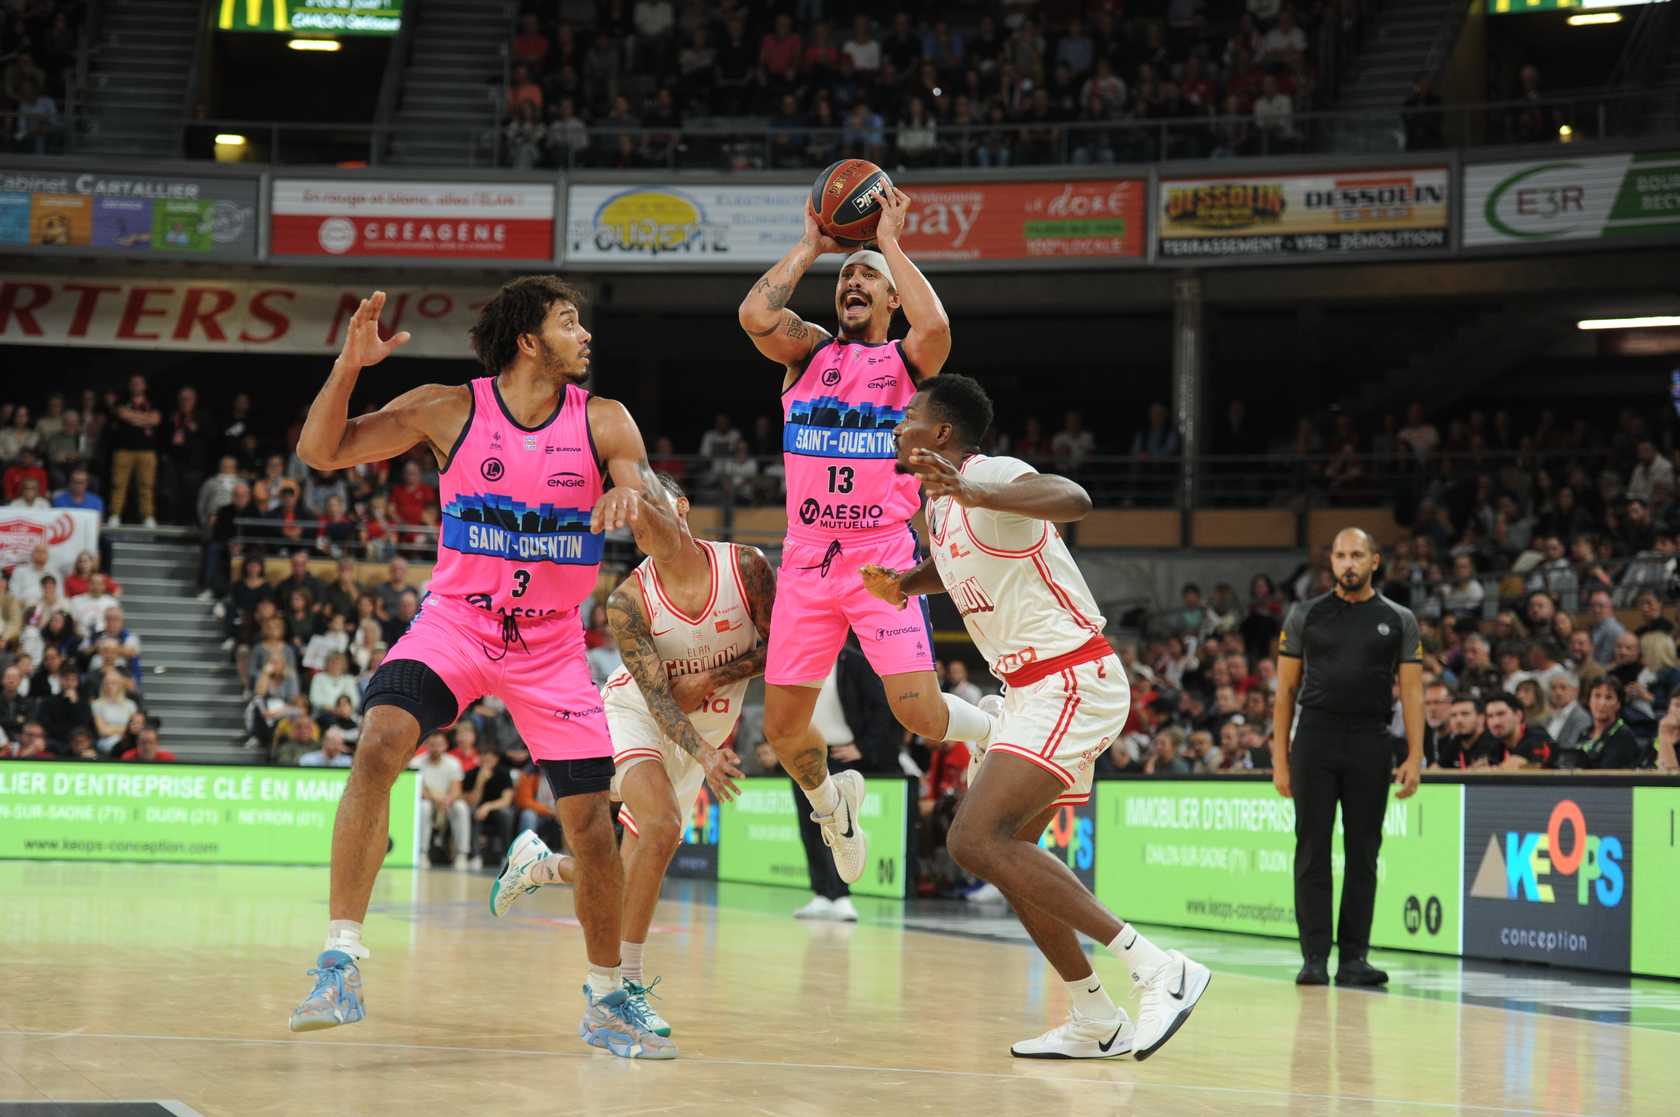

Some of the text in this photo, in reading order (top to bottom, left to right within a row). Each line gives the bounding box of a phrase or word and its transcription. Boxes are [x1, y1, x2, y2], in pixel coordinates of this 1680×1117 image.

[0, 174, 199, 199] abinet CARTALLIER
[1517, 187, 1584, 218] E3R
[827, 466, 854, 494] 13
[820, 520, 880, 529] MUTUELLE
[821, 503, 883, 519] AÉSIO
[512, 569, 531, 598] 3
[662, 643, 740, 681] CHALON
[53, 773, 207, 800] D'ENTREPRISE
[213, 773, 255, 801] CLÉ
[260, 778, 289, 801] EN
[1505, 799, 1625, 908] KEOPS
[1500, 927, 1588, 952] conception
